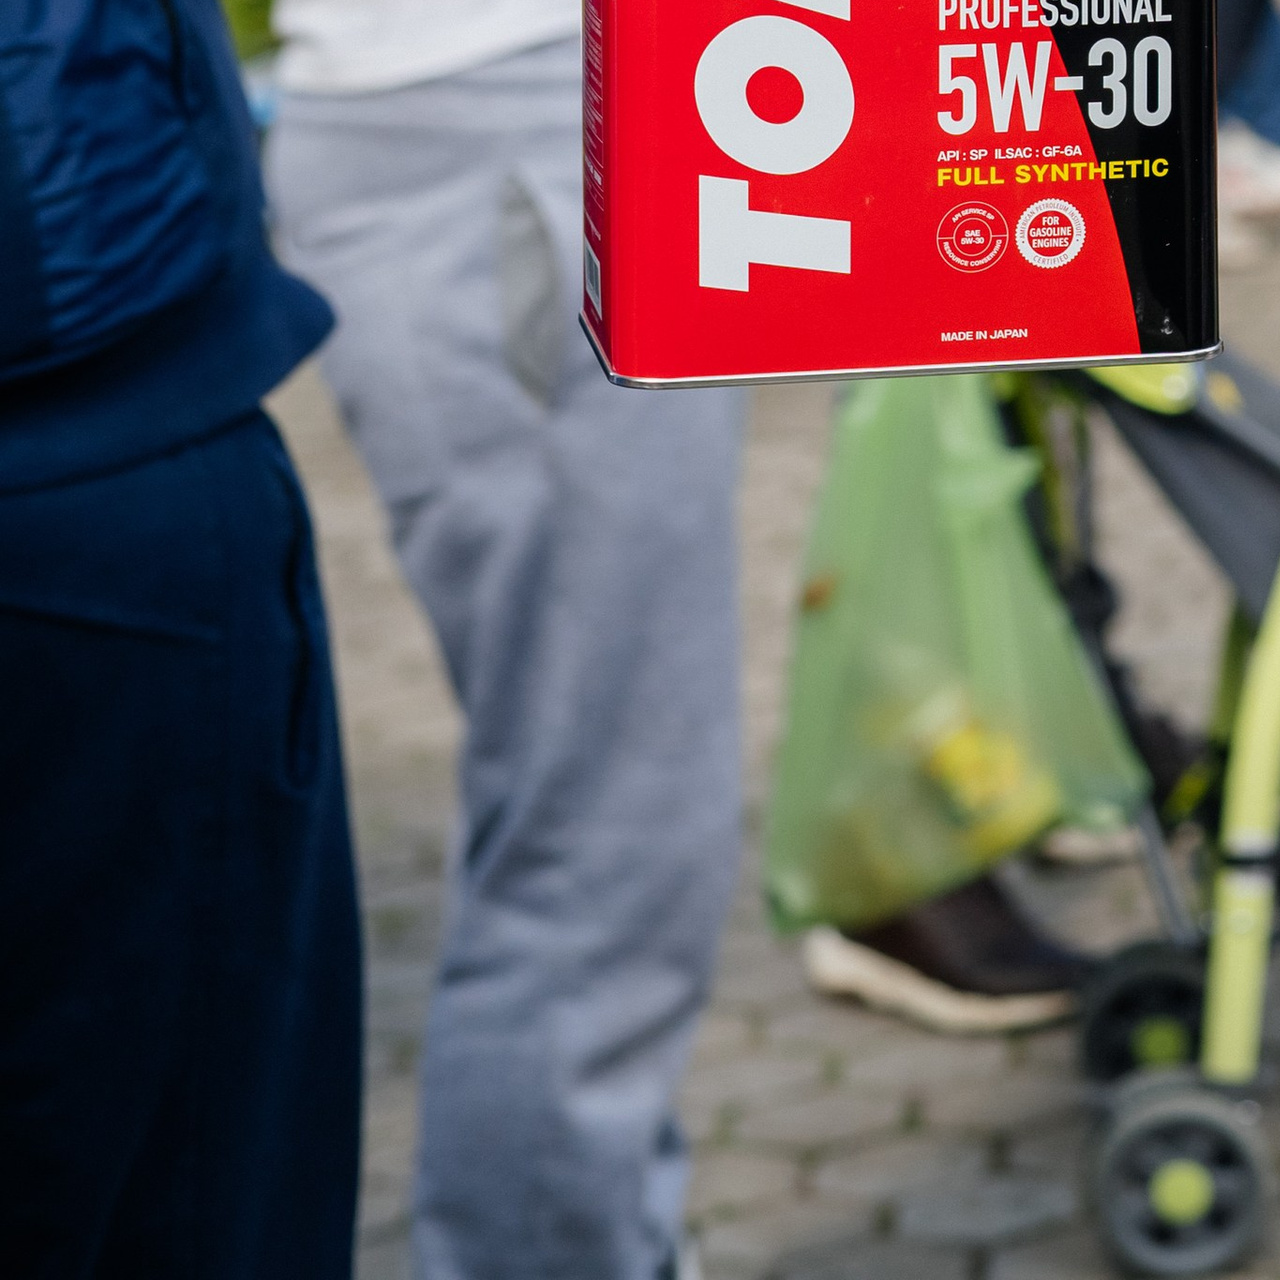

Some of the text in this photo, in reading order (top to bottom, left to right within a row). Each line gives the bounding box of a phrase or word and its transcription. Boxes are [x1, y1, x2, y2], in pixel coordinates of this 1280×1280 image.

[937, 35, 1172, 135] 5W-30
[937, 150, 959, 162] API
[969, 149, 988, 161] SP
[995, 148, 1032, 160] ILSAC
[1042, 145, 1082, 157] GF-6A
[937, 158, 1169, 187] FULL SYNTHETIC
[961, 208, 987, 216] SERVICE
[1020, 202, 1081, 238] AMERICAN PETROLEUM INSTITUTE
[1042, 216, 1059, 226] FOR
[964, 229, 981, 237] SAE
[1029, 226, 1072, 237] GASOLINE
[961, 237, 985, 245] 5W-30
[1032, 237, 1069, 248] ENGINES
[943, 239, 1002, 267] RESOURCE CONSERVING
[1033, 253, 1069, 265] CERTIFIED
[941, 328, 1028, 342] MADE IN JAPAN
